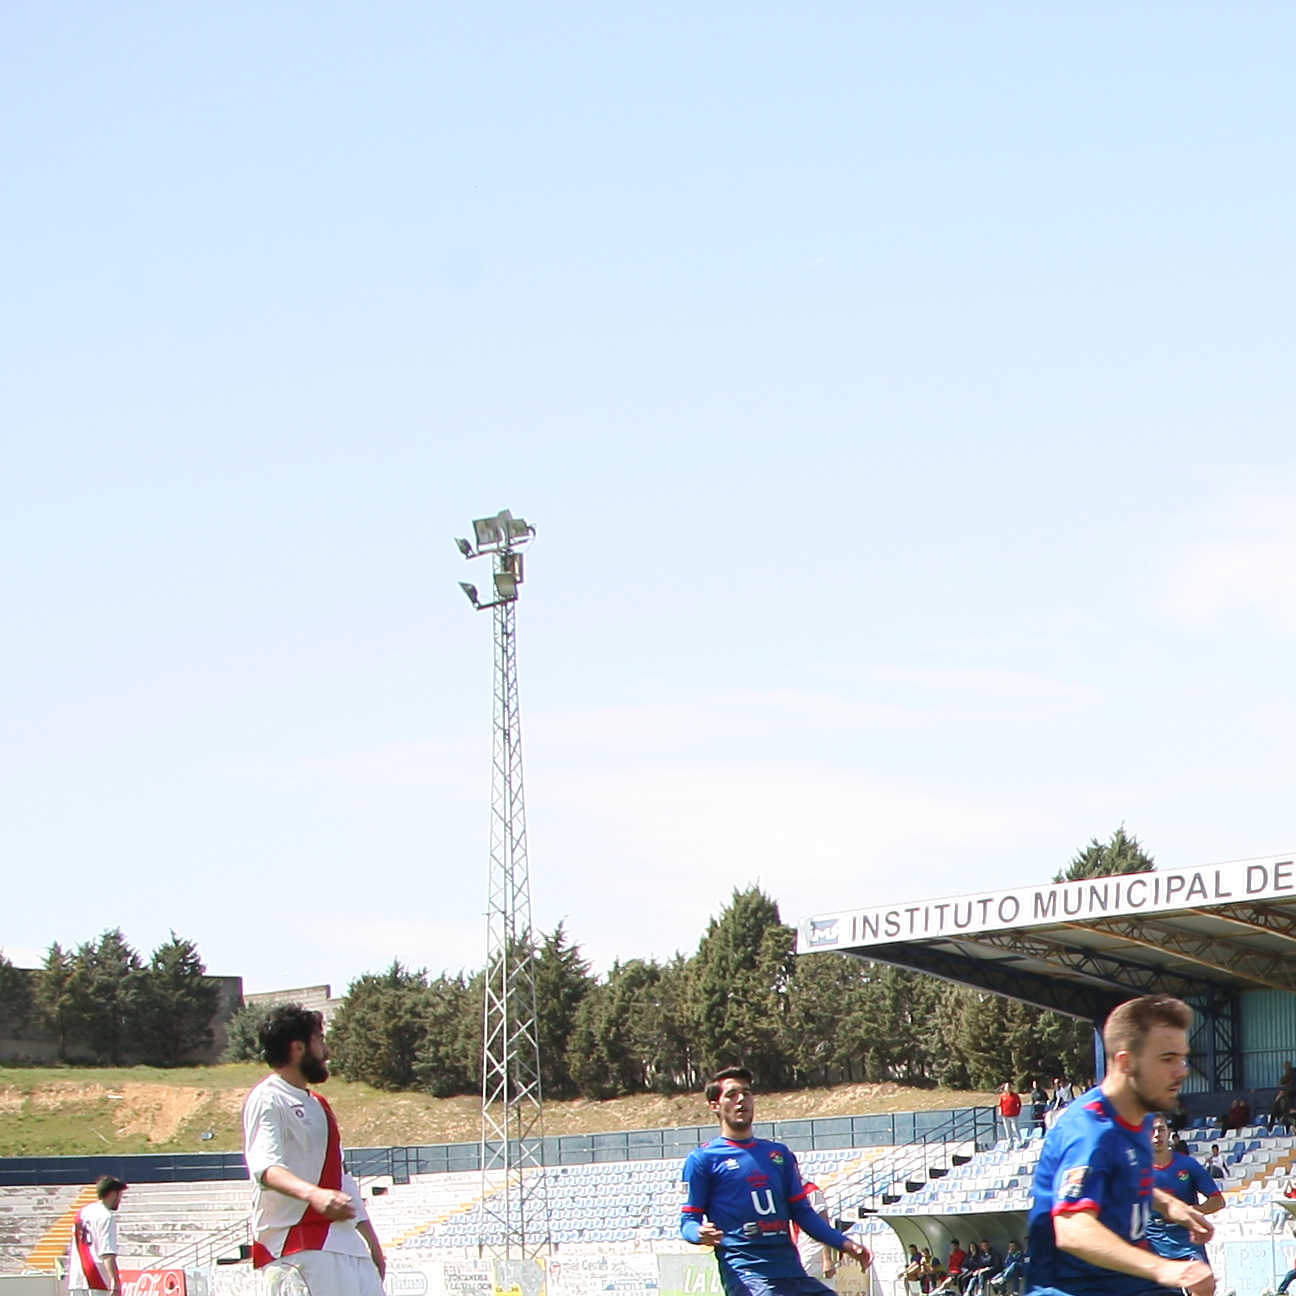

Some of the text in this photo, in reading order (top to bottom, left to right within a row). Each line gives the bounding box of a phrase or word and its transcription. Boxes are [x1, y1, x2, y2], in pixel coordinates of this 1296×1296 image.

[851, 895, 1020, 942] INSTITUTO
[1033, 869, 1232, 920] MUNICIPAL
[1246, 860, 1294, 894] DE
